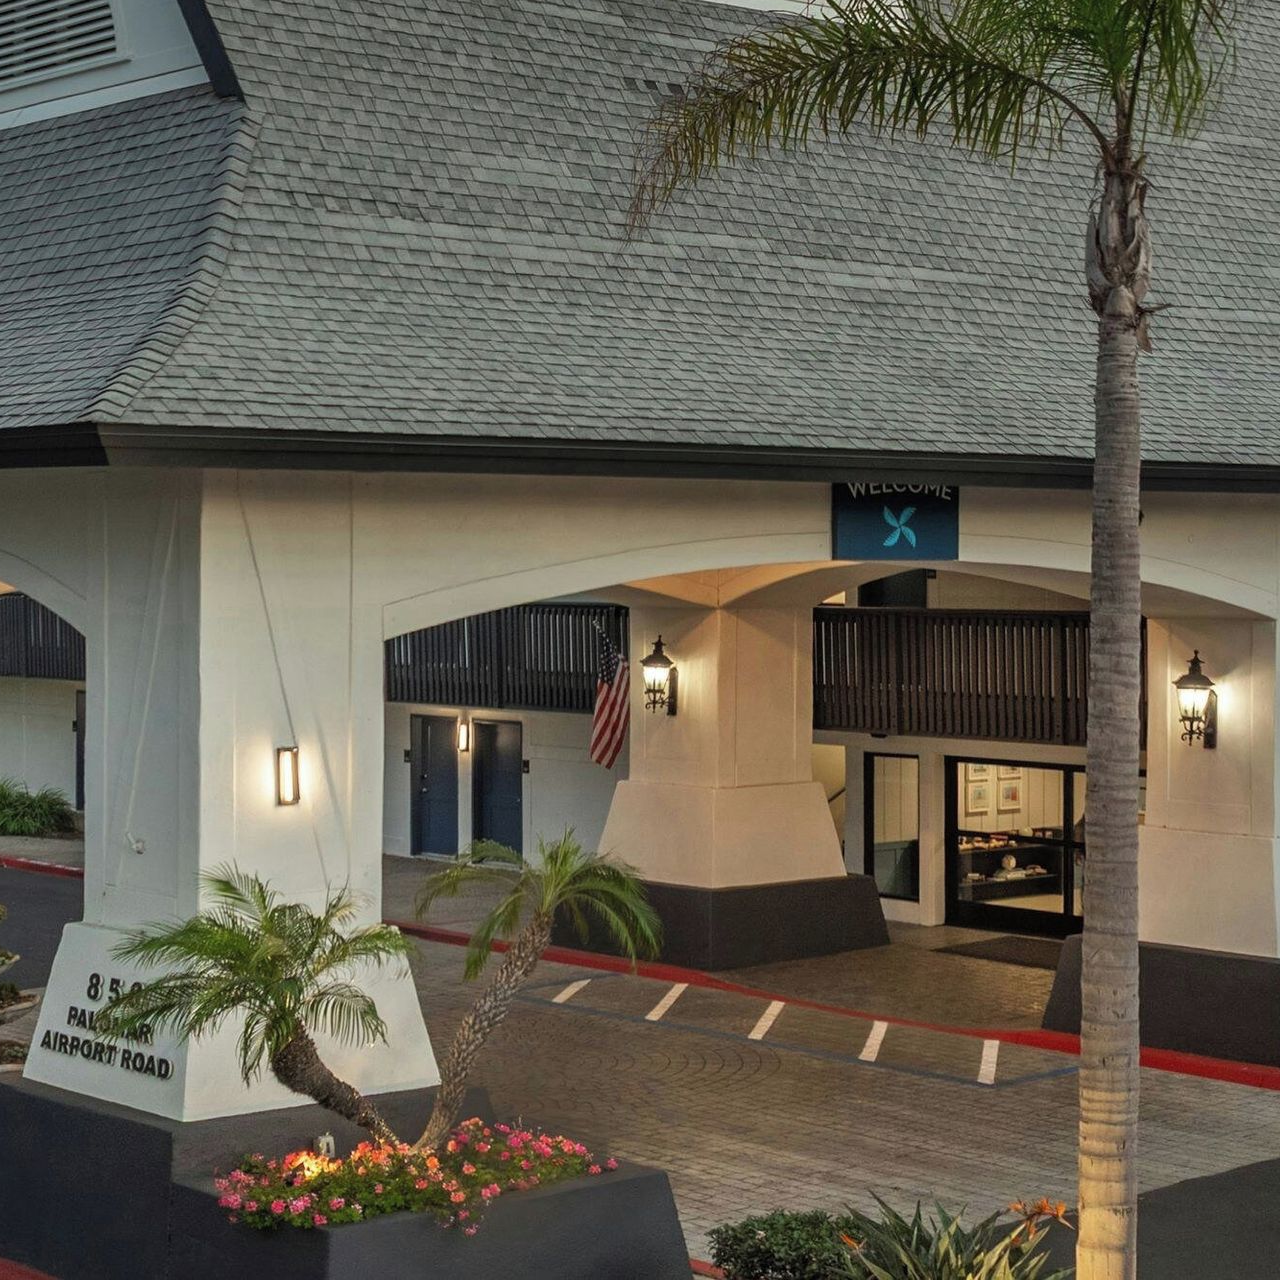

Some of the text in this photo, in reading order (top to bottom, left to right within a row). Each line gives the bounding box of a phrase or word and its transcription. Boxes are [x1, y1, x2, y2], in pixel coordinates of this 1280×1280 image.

[847, 482, 952, 501] WELCOME
[39, 1029, 174, 1080] AIRPORT ROAD
